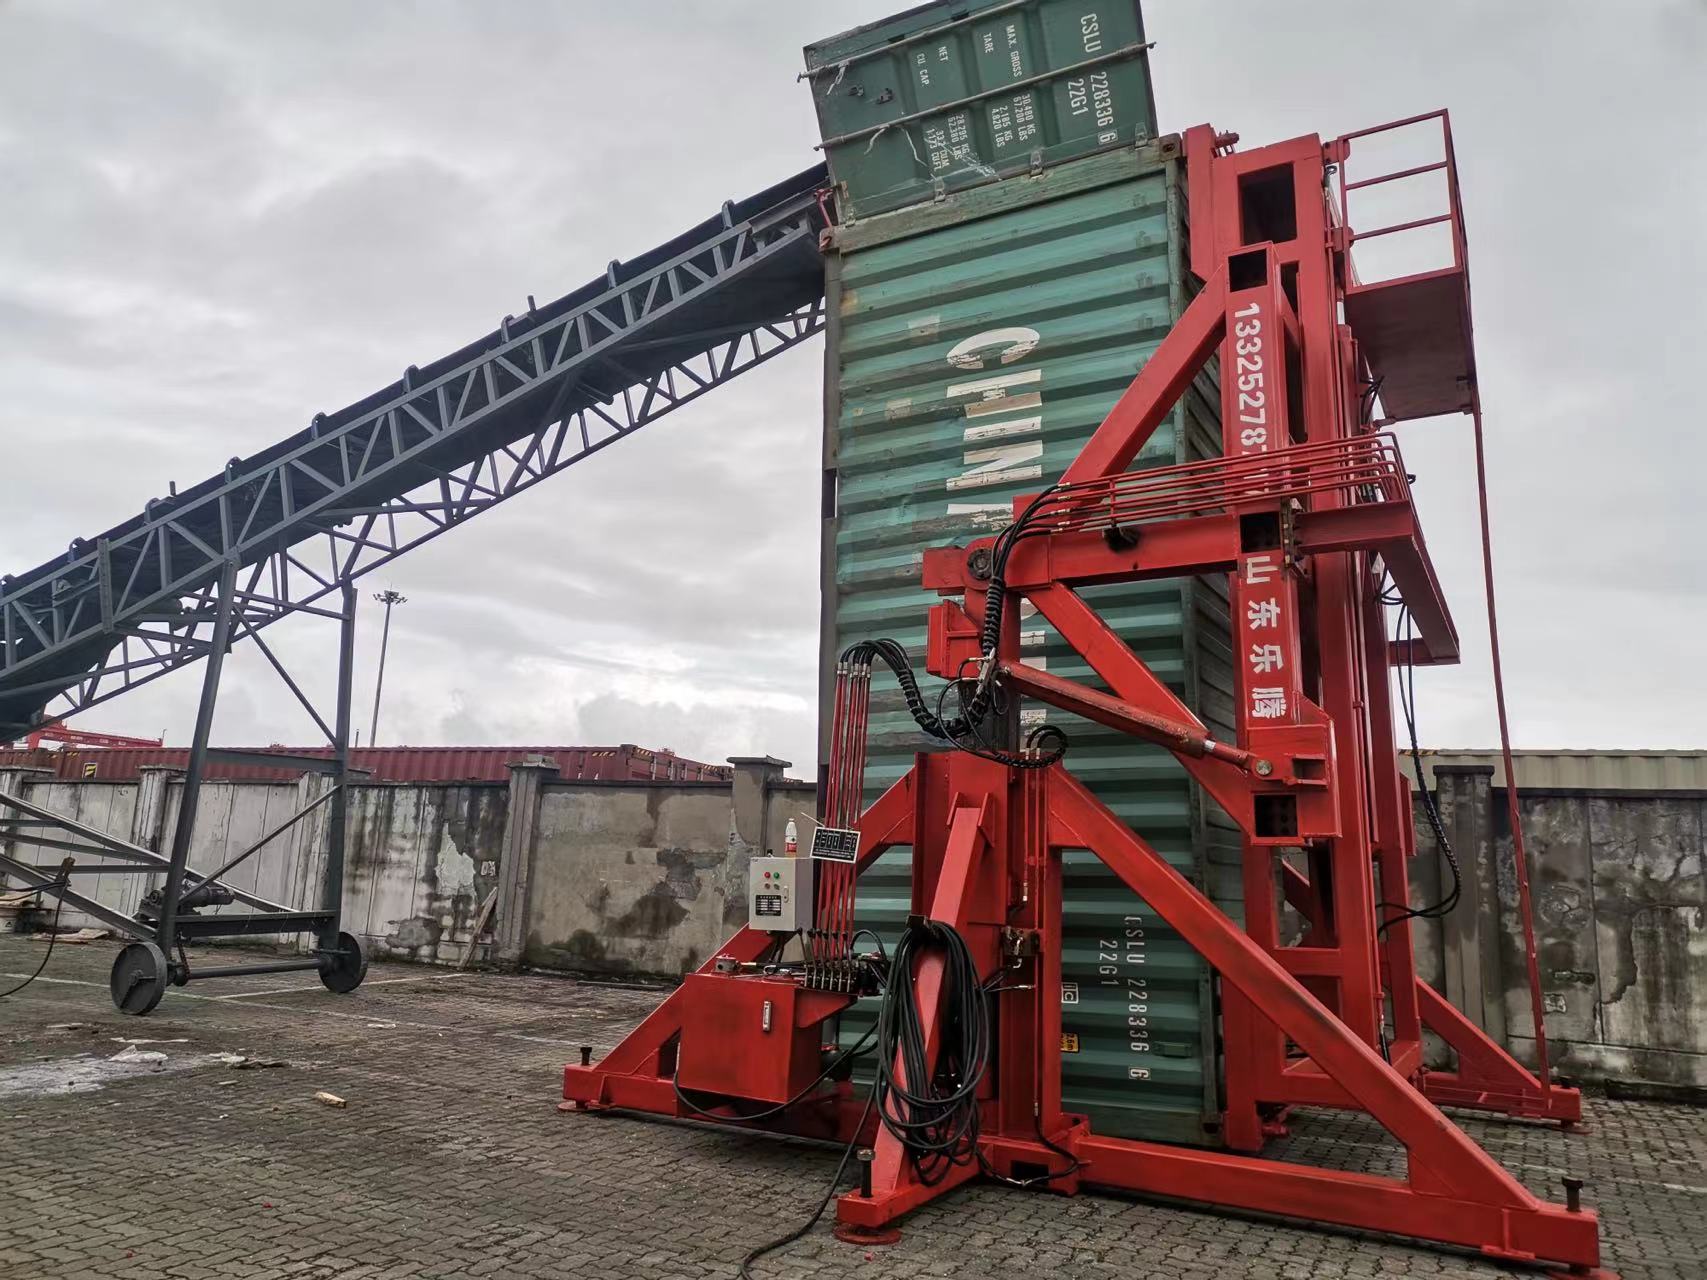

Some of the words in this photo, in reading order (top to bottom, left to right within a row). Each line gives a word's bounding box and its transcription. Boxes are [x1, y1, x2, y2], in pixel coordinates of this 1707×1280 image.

[983, 32, 994, 54] TARE
[1006, 25, 1017, 48] MAX.
[1080, 13, 1102, 53] CSLU
[938, 46, 949, 62] NET
[1010, 50, 1022, 77] GROSS
[1022, 93, 1034, 121] 30.480
[1067, 78, 1089, 115] 22G1
[1090, 71, 1114, 127] 228336
[999, 105, 1011, 127] 2.185
[1013, 96, 1025, 123] 67.200
[995, 132, 1006, 148] LBS
[1004, 130, 1013, 141] KG
[1018, 126, 1028, 141] LBS
[1027, 123, 1036, 135] KG
[1099, 131, 1116, 143] 6
[952, 145, 963, 160] LBS
[961, 143, 969, 154] KG
[1124, 916, 1145, 964] CSLU
[1100, 939, 1119, 986] 22G1
[1127, 978, 1149, 1052] 228336
[1130, 1067, 1149, 1079] 6
